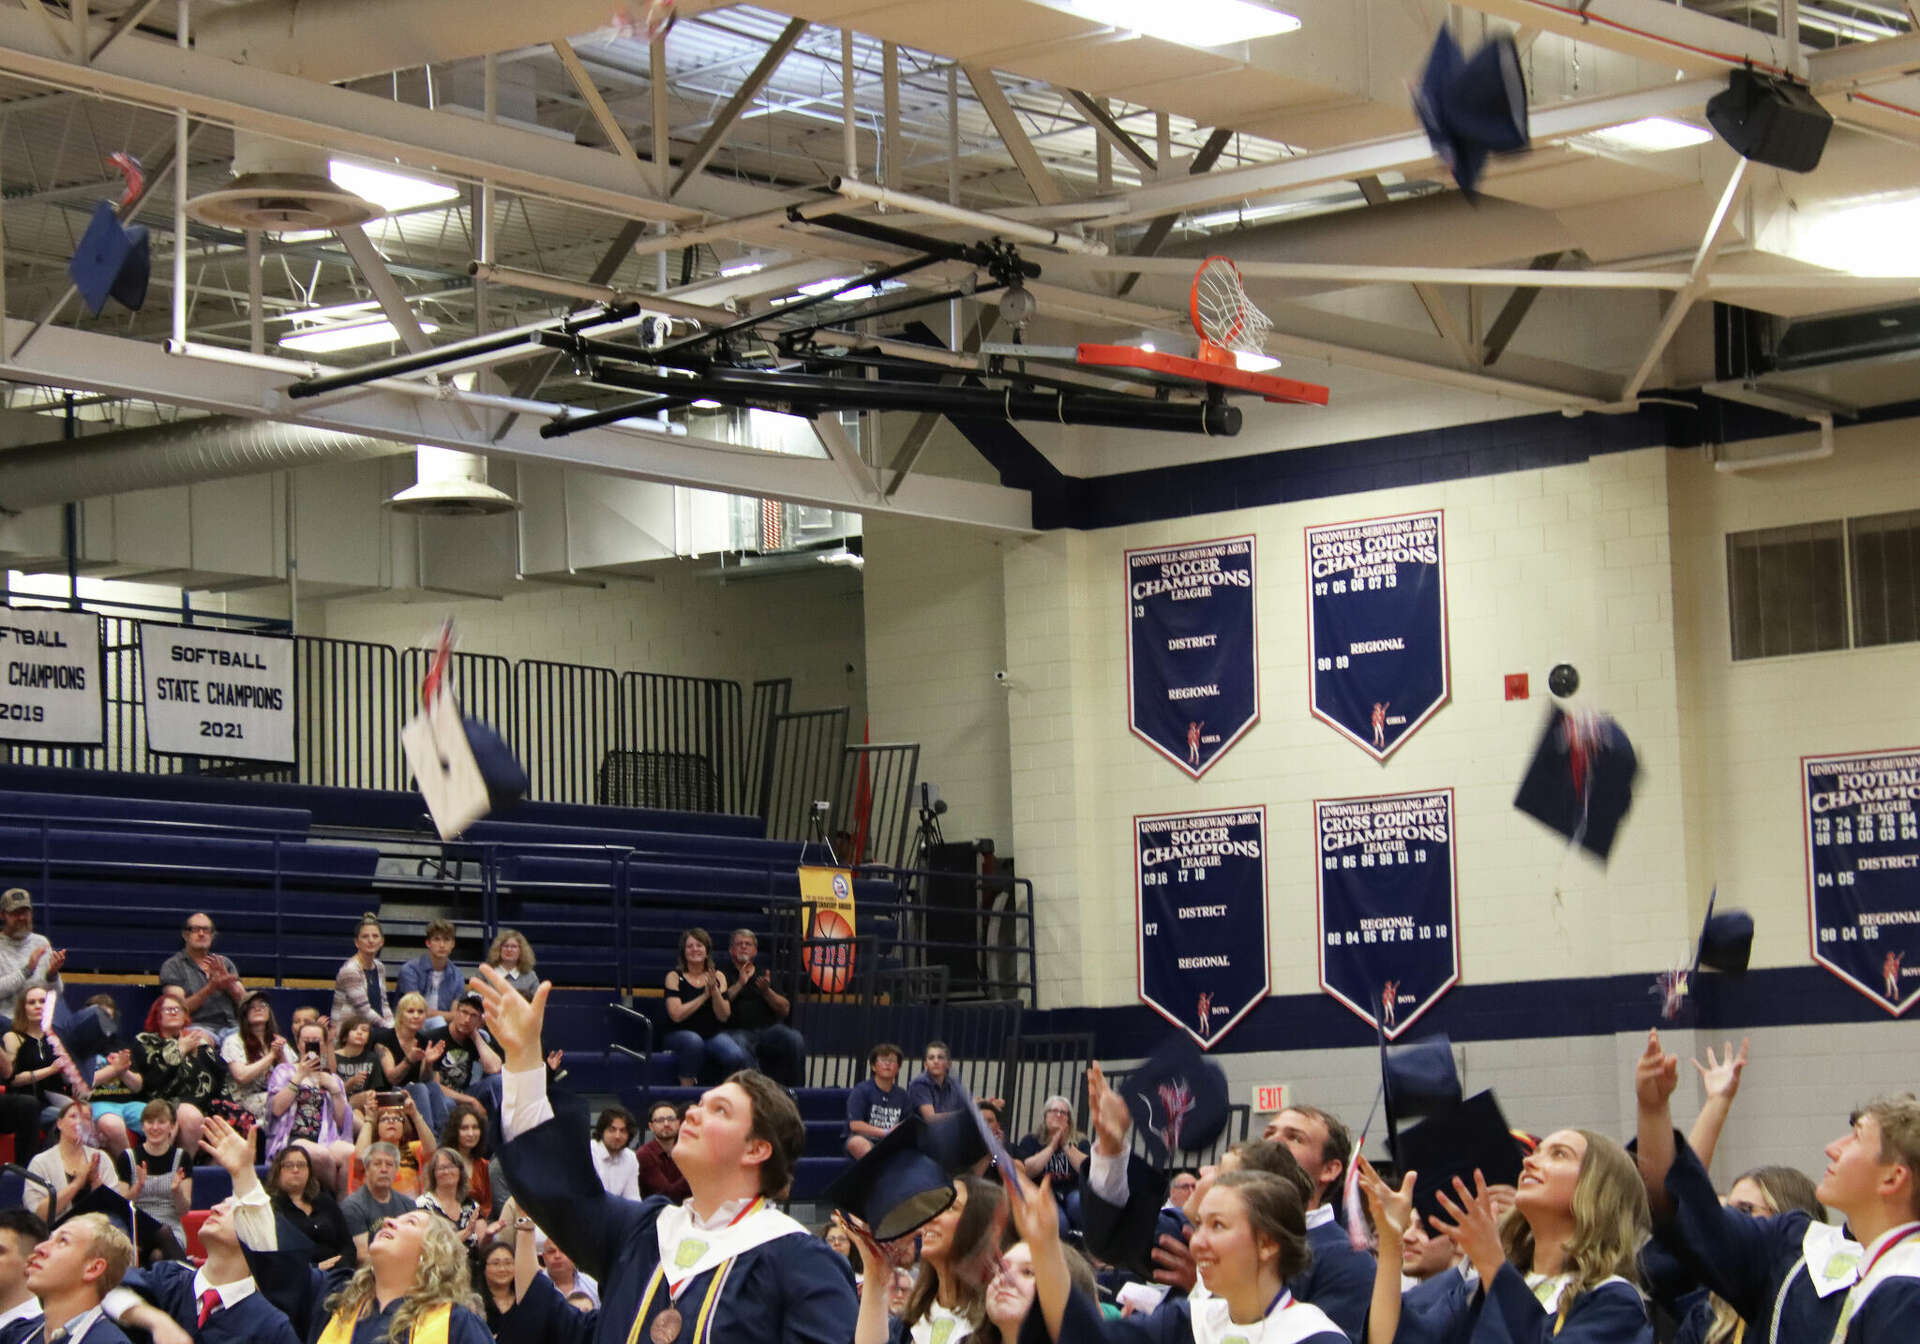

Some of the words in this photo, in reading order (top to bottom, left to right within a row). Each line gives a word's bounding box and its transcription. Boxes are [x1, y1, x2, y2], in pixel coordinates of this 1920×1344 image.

[1413, 517, 1436, 530] AREA
[1227, 543, 1250, 554] AREA
[1313, 540, 1361, 559] CROSS
[1364, 530, 1437, 552] COUNTRY
[1161, 558, 1221, 578] SOCCER
[1313, 546, 1438, 578] CHAMPIONS
[1353, 563, 1397, 579] LEAGUE
[1133, 569, 1251, 600] CHAMPIONS
[1171, 586, 1212, 601] LEAGUE
[1168, 634, 1218, 651] DISTRICT
[1350, 637, 1405, 655] REGIONAL
[171, 645, 267, 670] SOFTBALL
[8, 661, 85, 690] CHAMPIONS
[157, 677, 200, 703] STATE
[207, 681, 283, 711] CHAMPIONS
[1168, 684, 1220, 700] REGIONAL
[0, 703, 44, 722] 2019
[200, 720, 244, 739] 2021
[1423, 796, 1446, 808] AREA
[1860, 800, 1911, 815] LEAGUE
[1141, 815, 1236, 833] UNIONVILLE-SEBEWAING
[1237, 813, 1259, 825] AREA
[1322, 814, 1371, 833] CROSS
[1373, 808, 1447, 828] COUNTRY
[1171, 827, 1230, 846] SOCCER
[1323, 824, 1448, 852] CHAMPIONS
[1143, 840, 1260, 866] CHAMPIONS
[1363, 840, 1407, 854] LEAGUE
[1181, 855, 1222, 869] LEAGUE
[1858, 854, 1919, 870] DISTRICT
[1178, 870, 1189, 882] 17
[1818, 873, 1833, 887] 04
[1178, 904, 1228, 919] DISTRICT
[1145, 923, 1158, 936] 07
[1360, 916, 1415, 930] REGIONAL
[1178, 955, 1230, 969] REGIONAL
[1397, 995, 1416, 1004] BOYS
[1211, 1006, 1230, 1015] BOYS
[1259, 1087, 1283, 1110] EXIT
